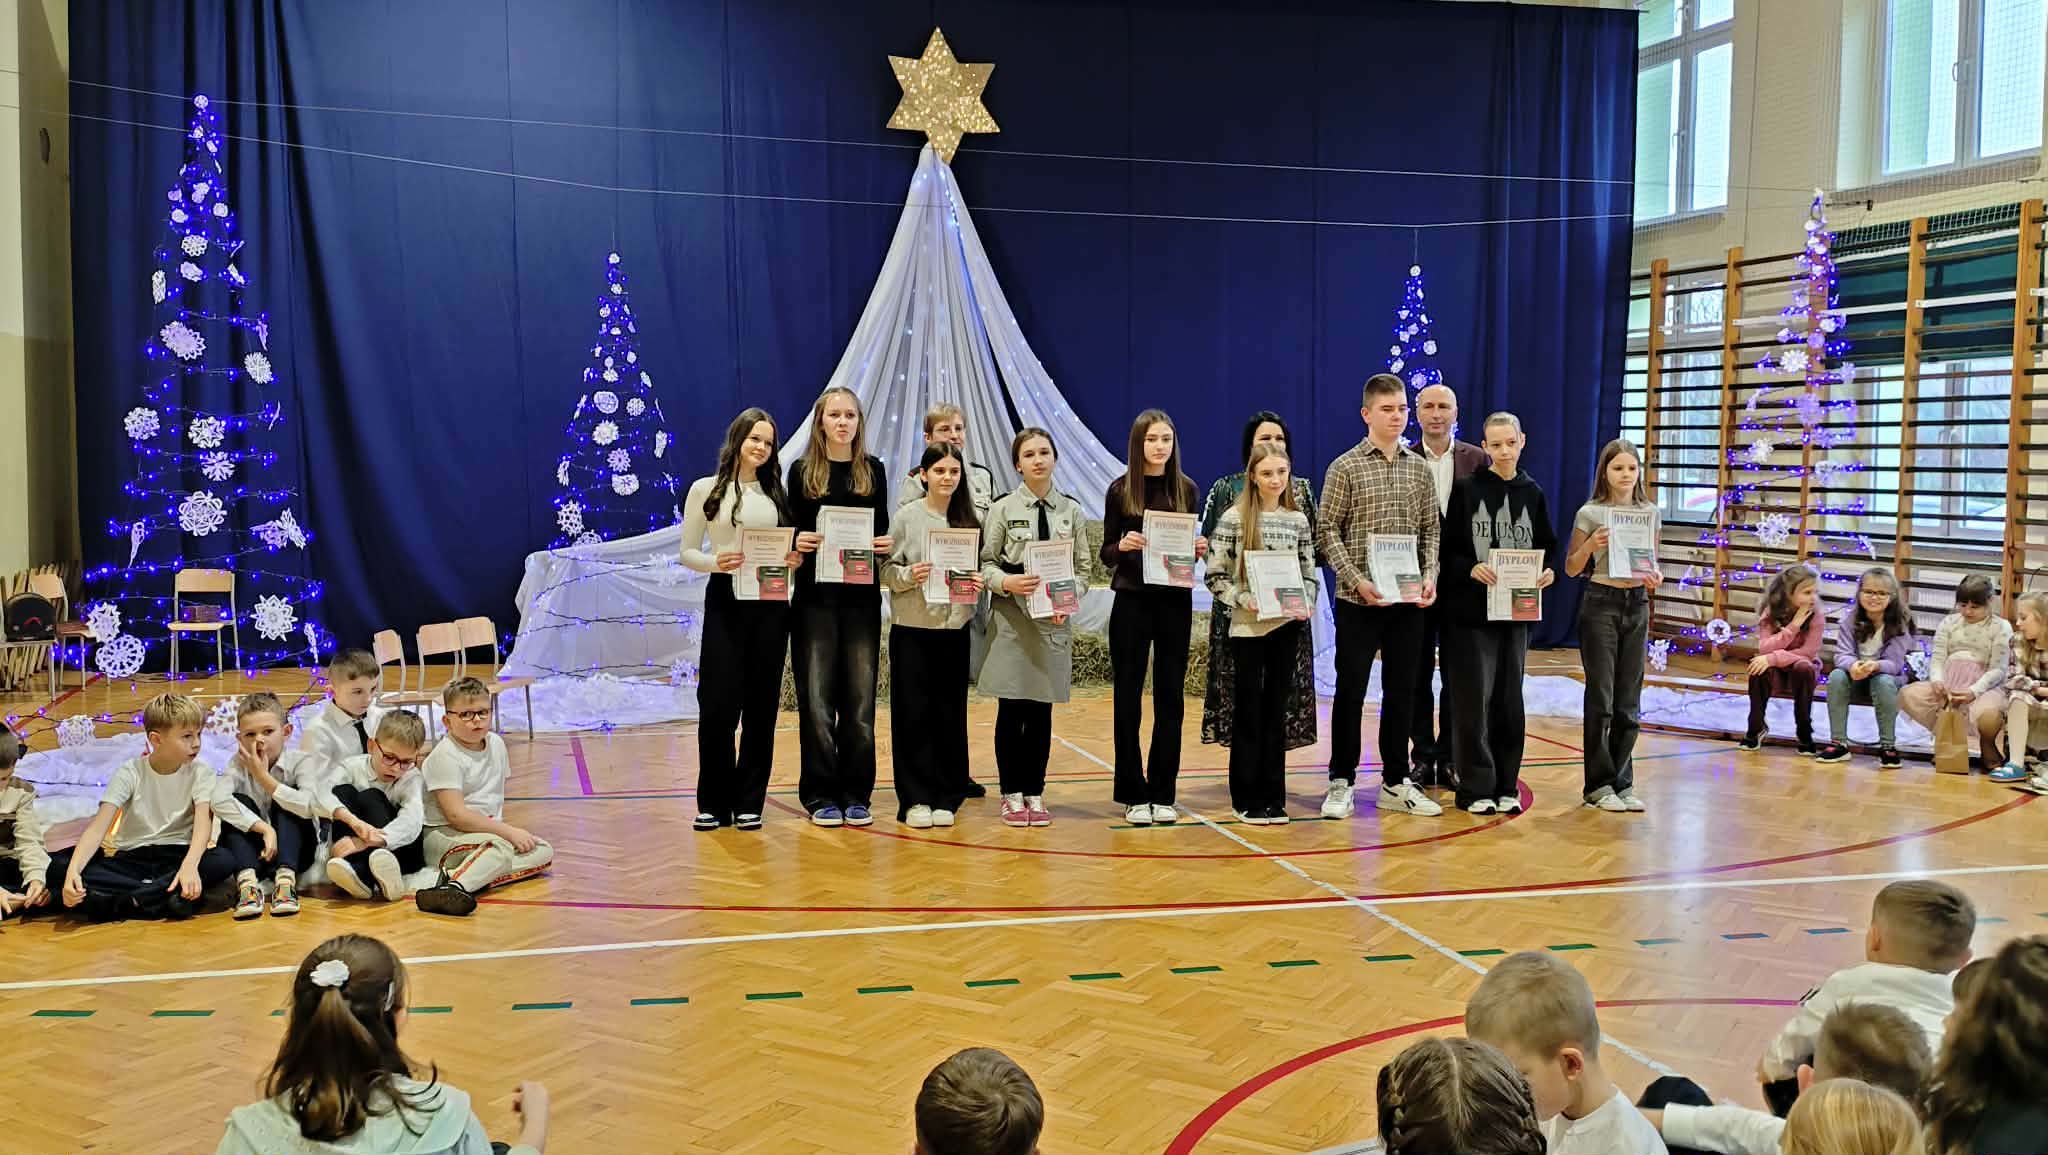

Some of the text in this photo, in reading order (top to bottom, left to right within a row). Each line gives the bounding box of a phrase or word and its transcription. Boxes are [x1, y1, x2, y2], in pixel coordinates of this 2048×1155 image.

[1614, 514, 1649, 527] DYPLOM
[1376, 541, 1411, 553] DYPLOM
[1498, 554, 1537, 566] DYPLOM
